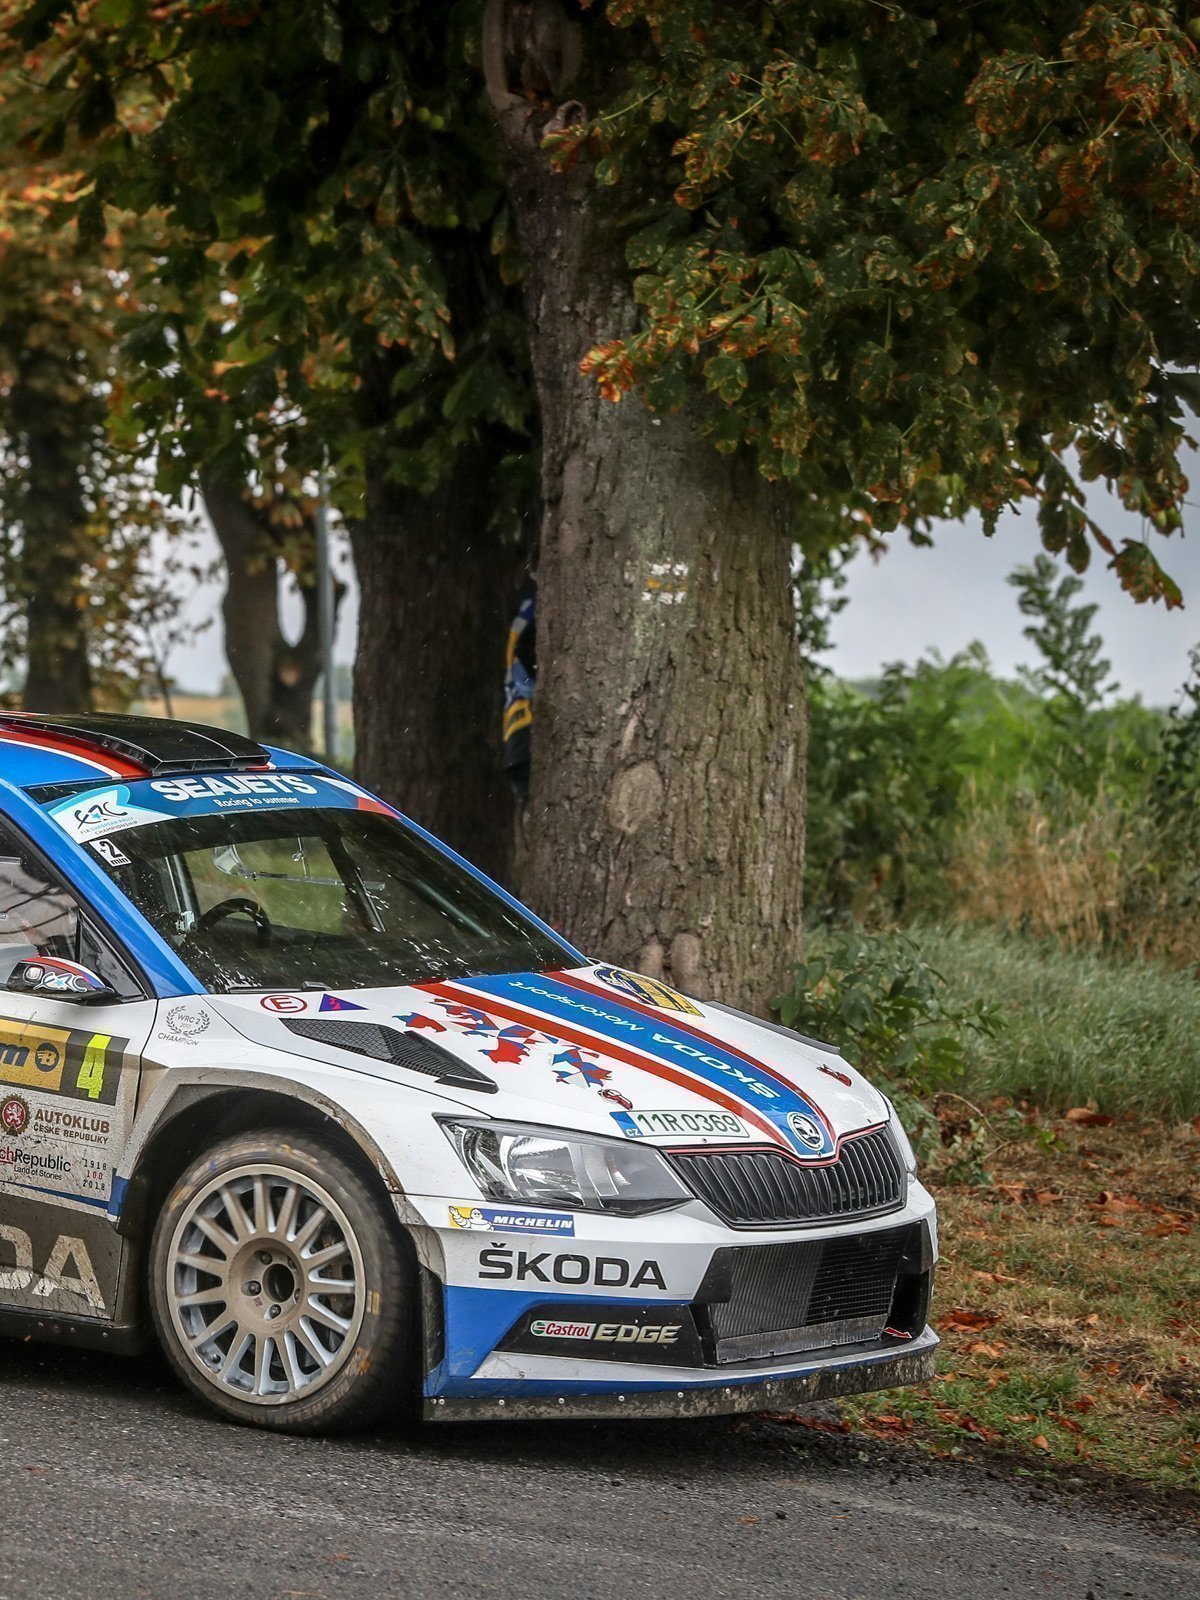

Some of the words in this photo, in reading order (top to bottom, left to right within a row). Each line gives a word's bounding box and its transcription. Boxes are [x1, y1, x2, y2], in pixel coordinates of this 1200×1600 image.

[150, 775, 318, 801] SEAJETS
[213, 798, 253, 807] Racing
[110, 857, 129, 866] min
[508, 981, 645, 1032] Motorsport
[177, 1013, 195, 1024] WRC
[157, 1032, 200, 1046] CHAMPION
[75, 1034, 112, 1100] 4
[652, 1032, 782, 1099] ŠKODA
[34, 1108, 111, 1134] AUTOKLUB
[63, 1129, 109, 1145] REPUBLIKY
[626, 1128, 641, 1136] CZ
[14, 1164, 31, 1175] Land
[39, 1169, 63, 1181] Stories
[86, 1170, 104, 1180] 100
[82, 1179, 106, 1191] 2018
[493, 1215, 573, 1229] MICHELIN
[478, 1242, 668, 1290] ŠKODA
[545, 1322, 591, 1338] Castrol
[594, 1323, 682, 1344] EDGE
